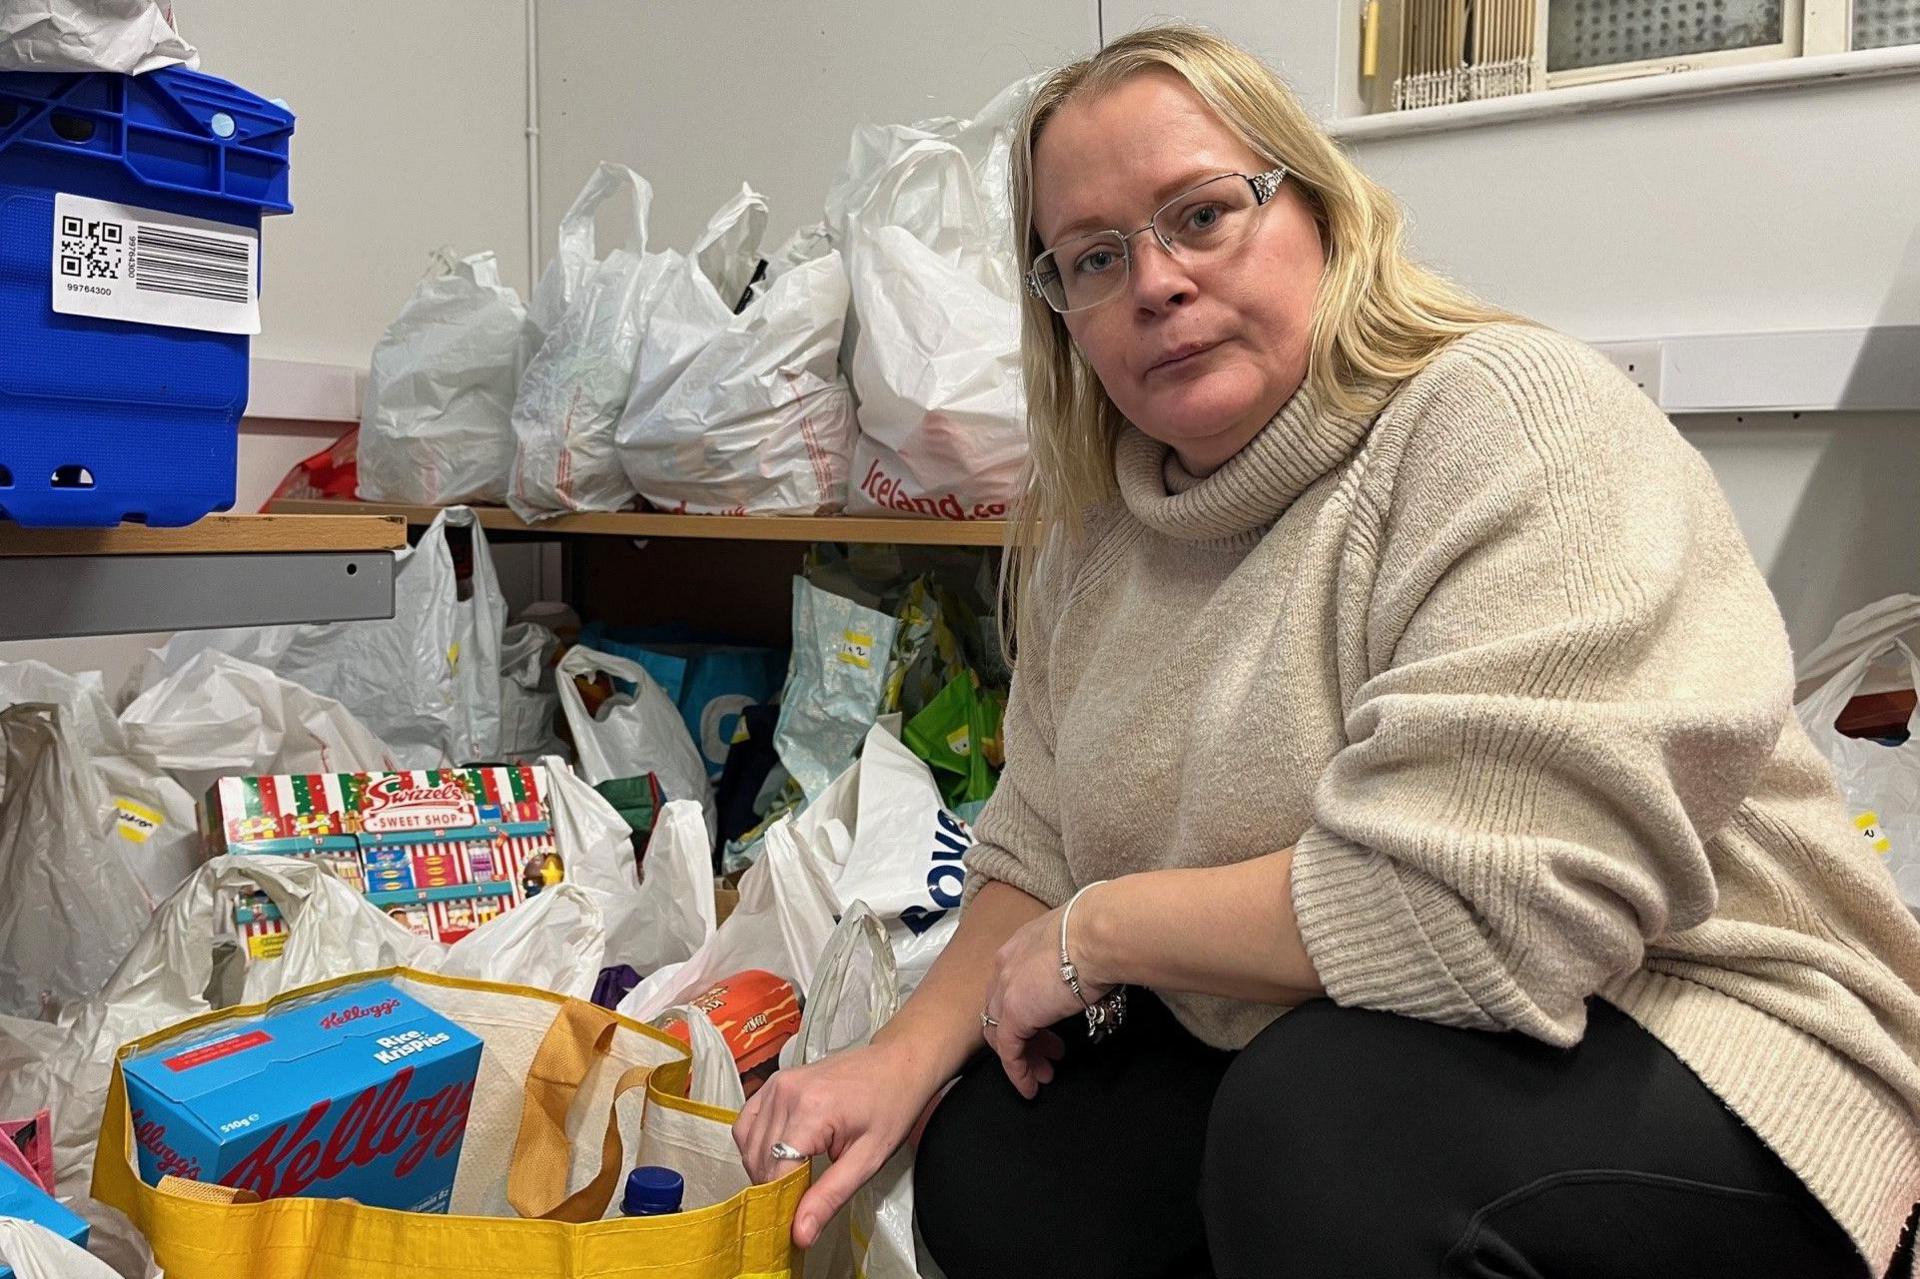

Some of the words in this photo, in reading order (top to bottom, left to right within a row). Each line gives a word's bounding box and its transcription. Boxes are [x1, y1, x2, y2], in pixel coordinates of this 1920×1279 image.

[128, 236, 136, 279] 99764300
[66, 283, 112, 296] 99764300
[860, 458, 1006, 521] Iceland.co
[379, 816, 421, 829] SWEET
[427, 813, 458, 827] SHOP
[320, 998, 401, 1029] Kellogg's
[373, 1032, 451, 1065] Krispies
[375, 1029, 422, 1050] Rice
[220, 1118, 251, 1133] 510g
